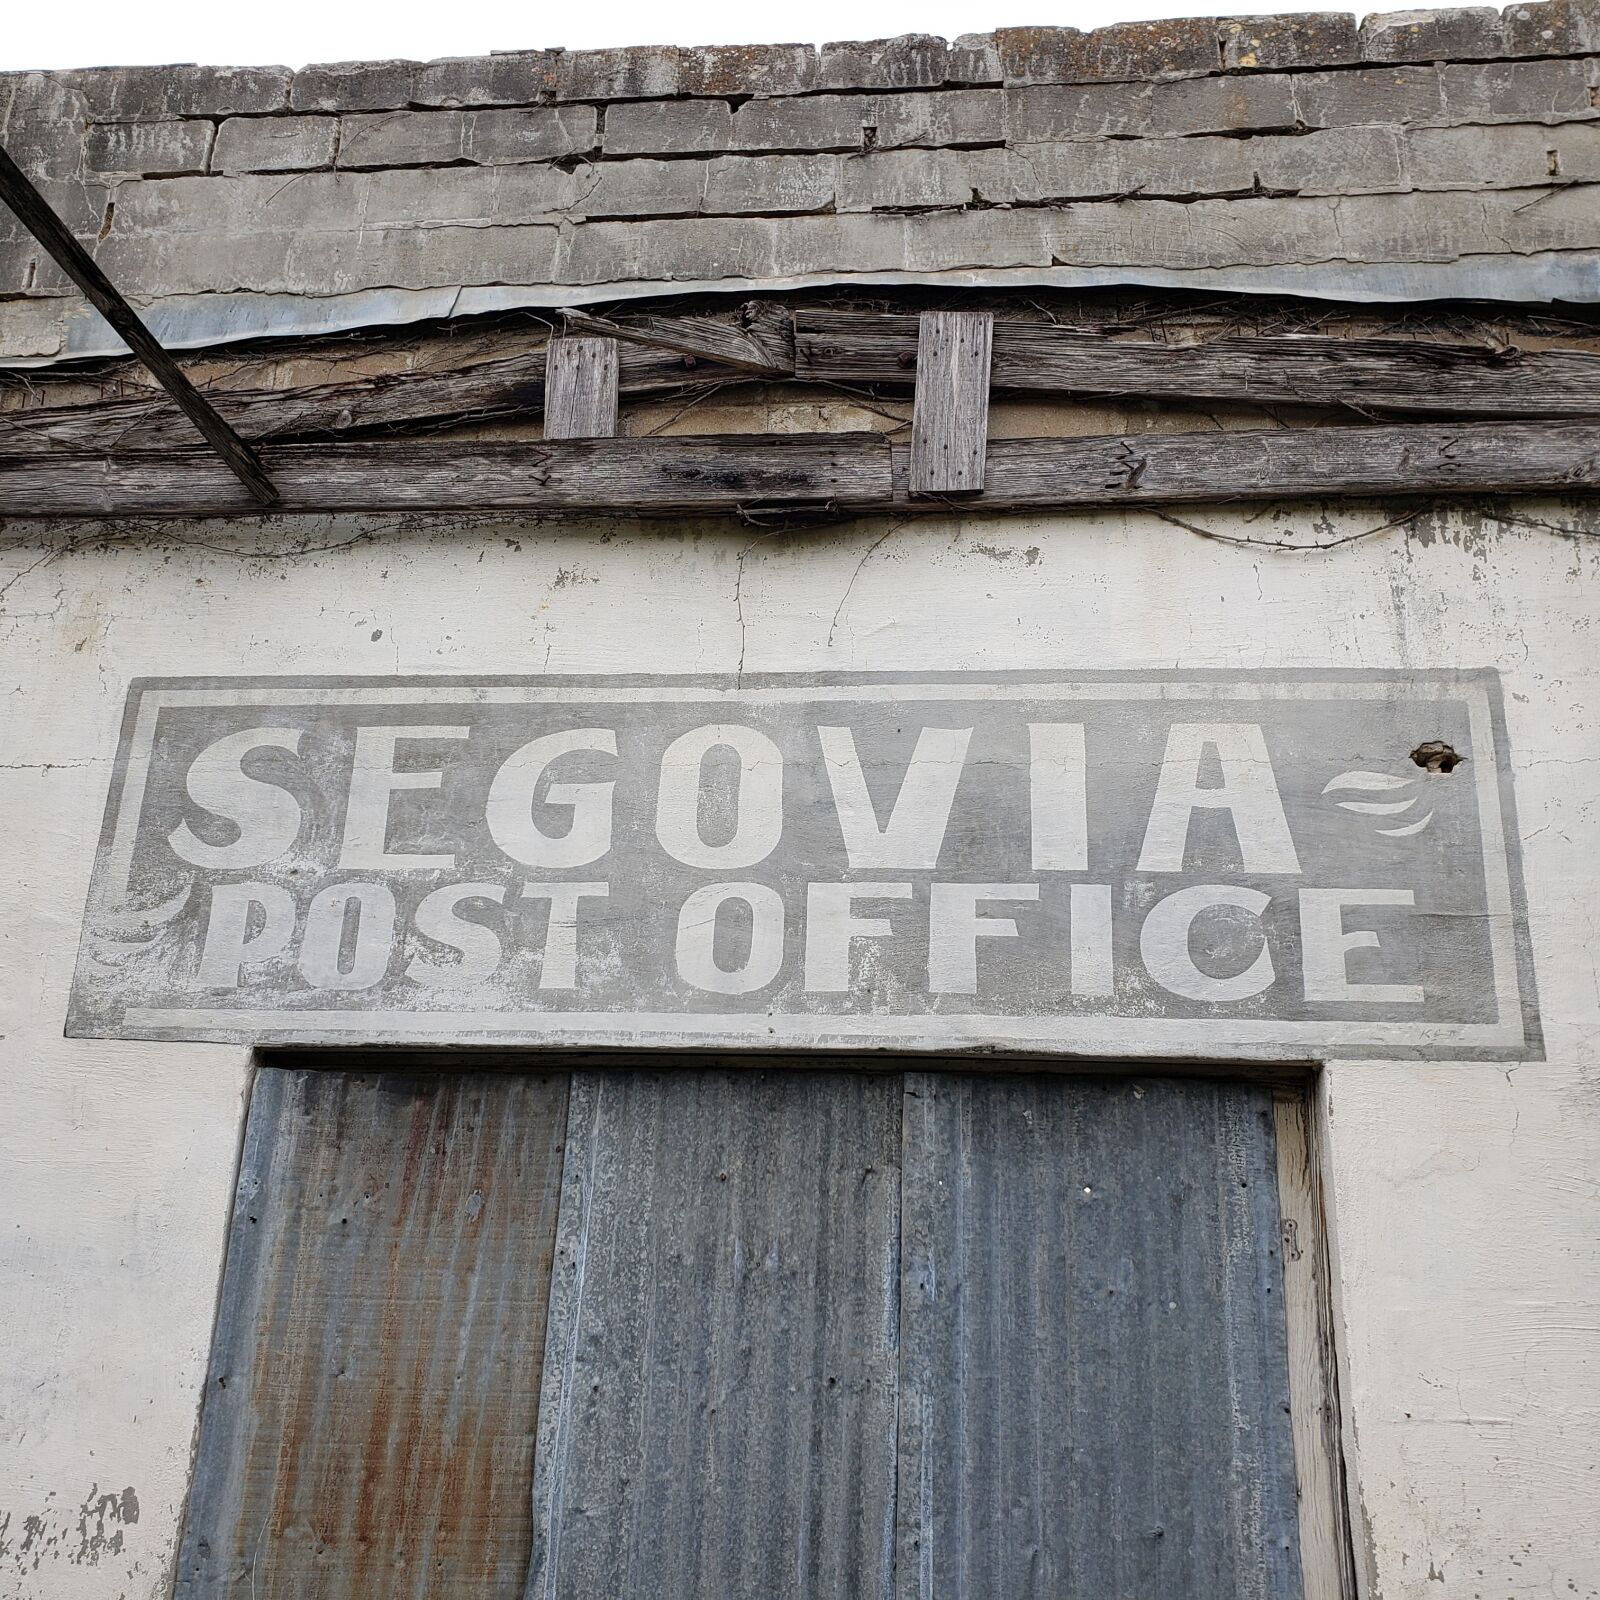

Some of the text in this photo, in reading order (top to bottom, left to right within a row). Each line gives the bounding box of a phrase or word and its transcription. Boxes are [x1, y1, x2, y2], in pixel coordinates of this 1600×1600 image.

[168, 723, 1302, 873] SEGOVIA
[201, 882, 1425, 1003] POST OFFICE
